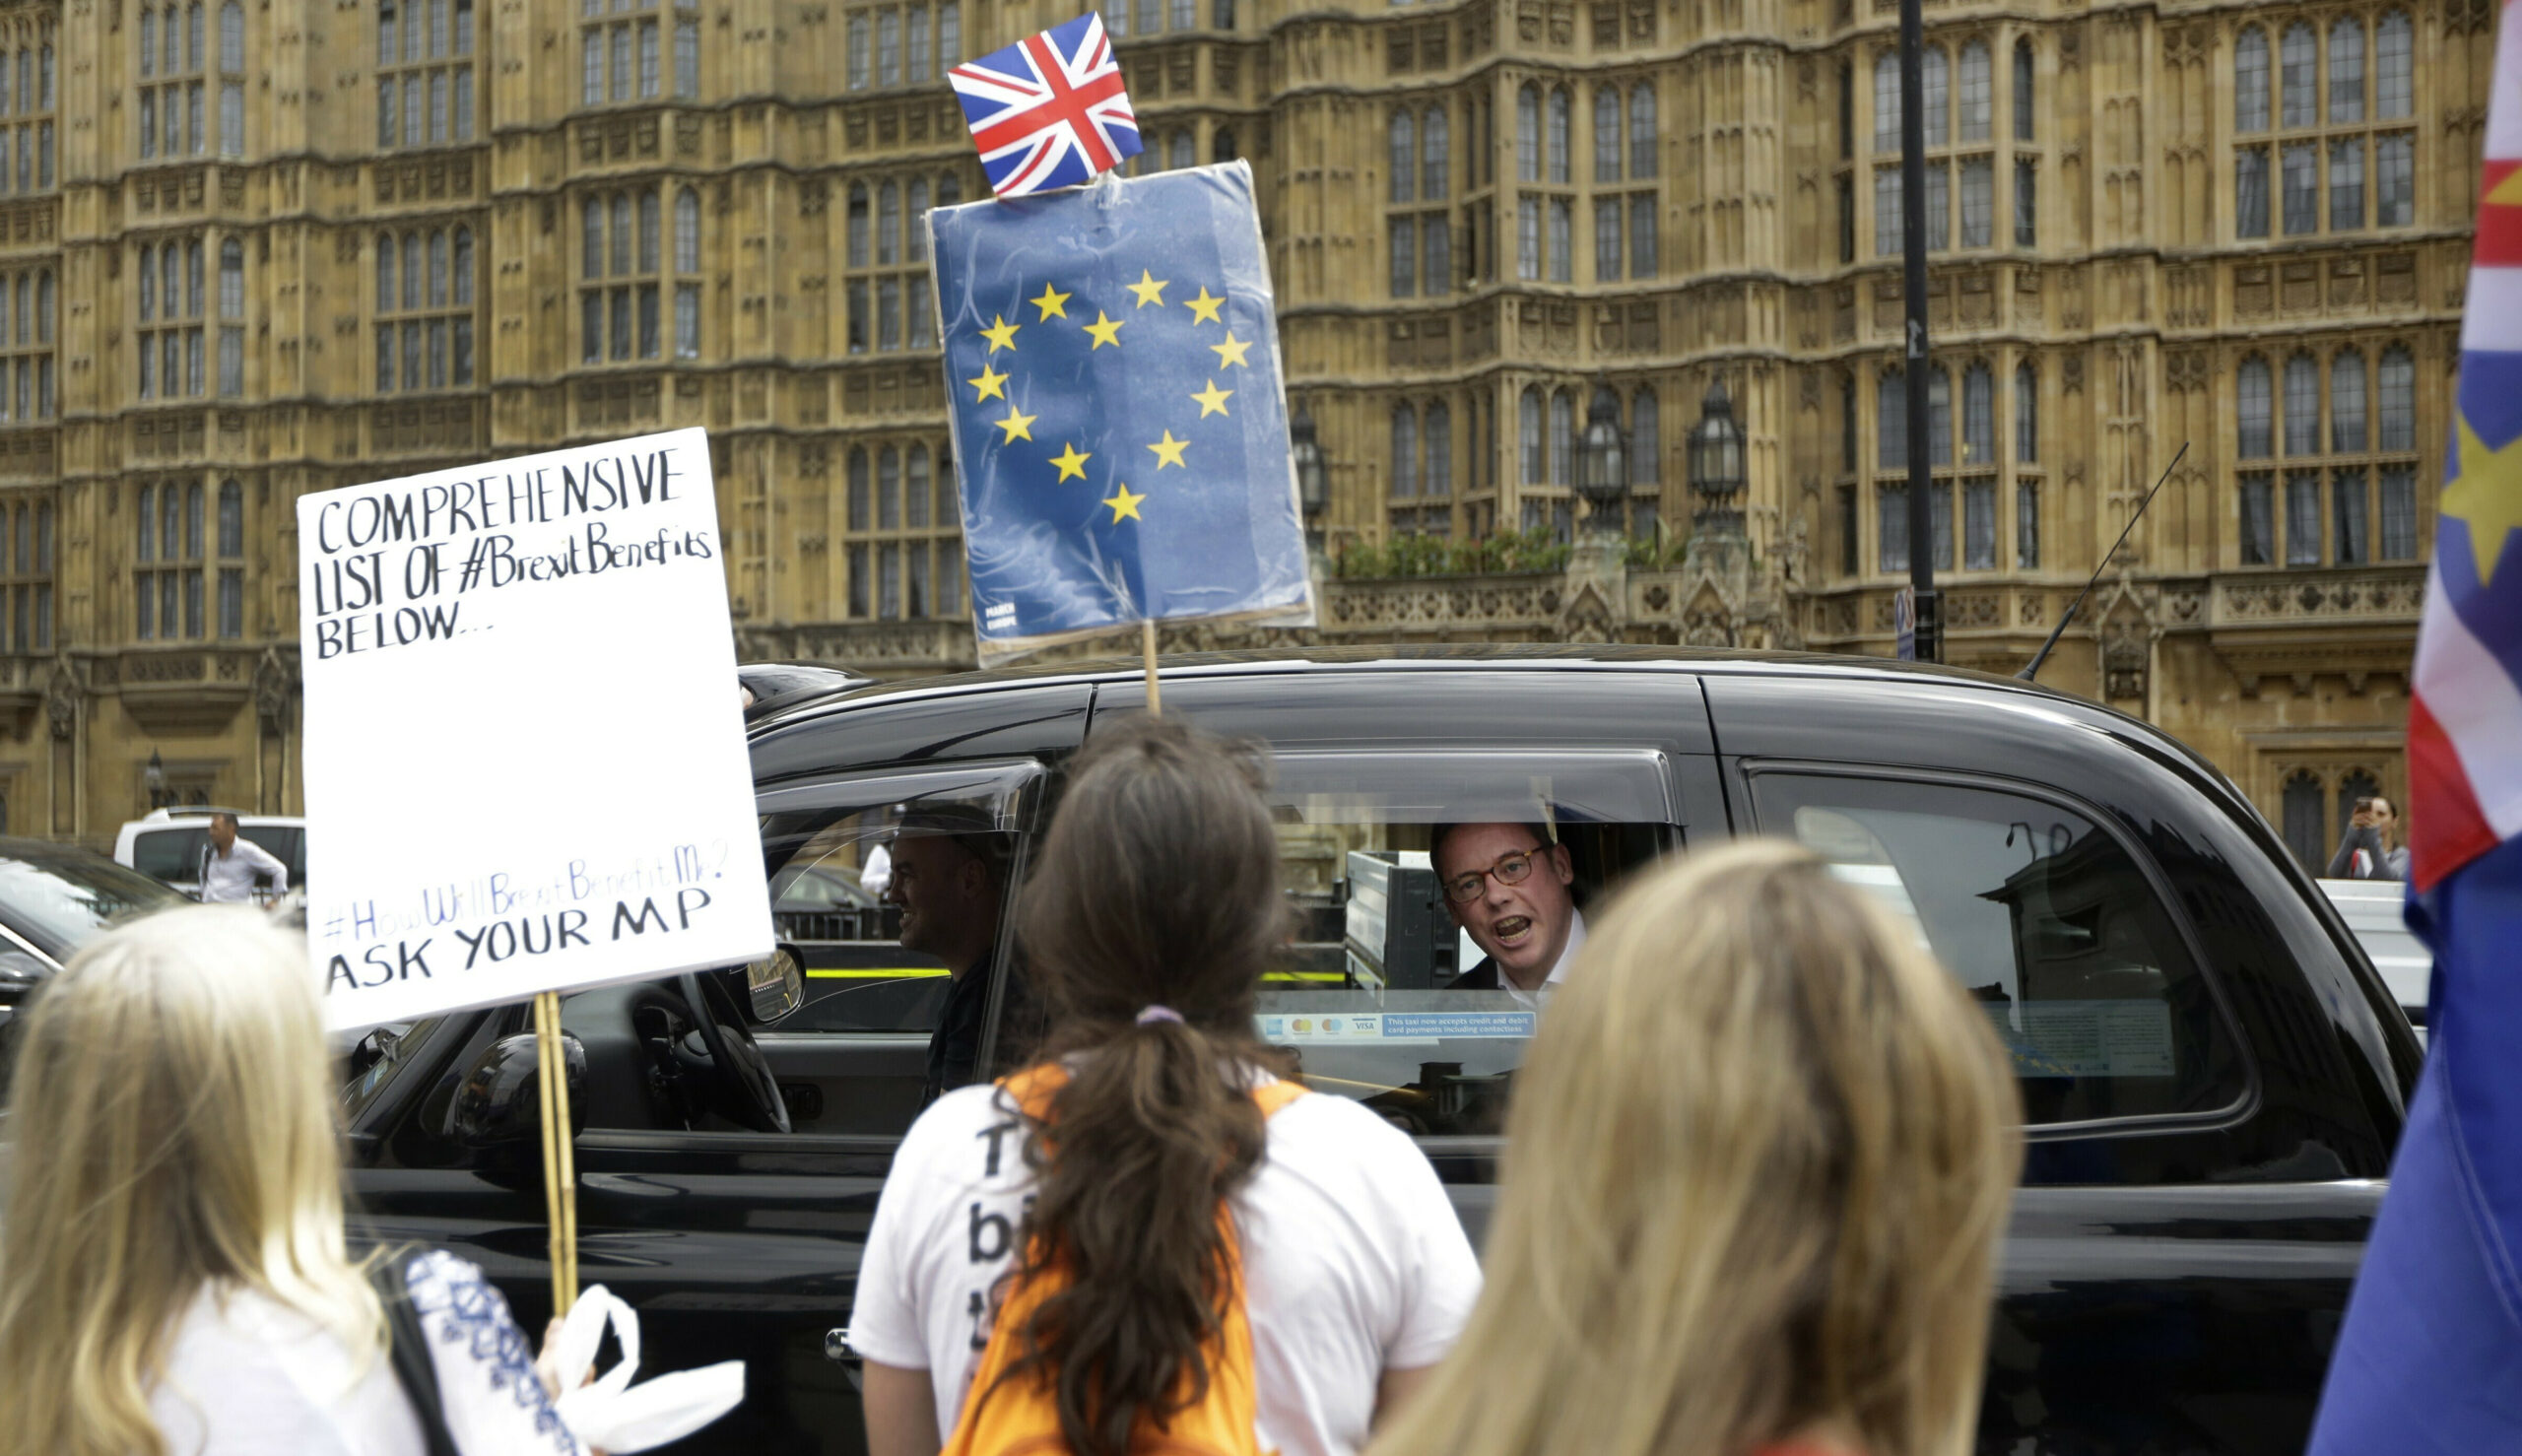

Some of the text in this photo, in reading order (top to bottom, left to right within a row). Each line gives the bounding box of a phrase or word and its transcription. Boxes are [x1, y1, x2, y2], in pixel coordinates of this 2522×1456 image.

[318, 448, 686, 555] COMPREHENSIVE
[313, 551, 387, 617] LIST
[405, 542, 450, 600] OF
[324, 888, 712, 996] ASK YOUR MP
[1406, 1026, 1443, 1034] payments
[1444, 1026, 1479, 1034] including
[1438, 1017, 1468, 1026] accepts
[1469, 1017, 1492, 1026] credit
[1493, 1017, 1507, 1026] and
[1508, 1017, 1529, 1026] debit
